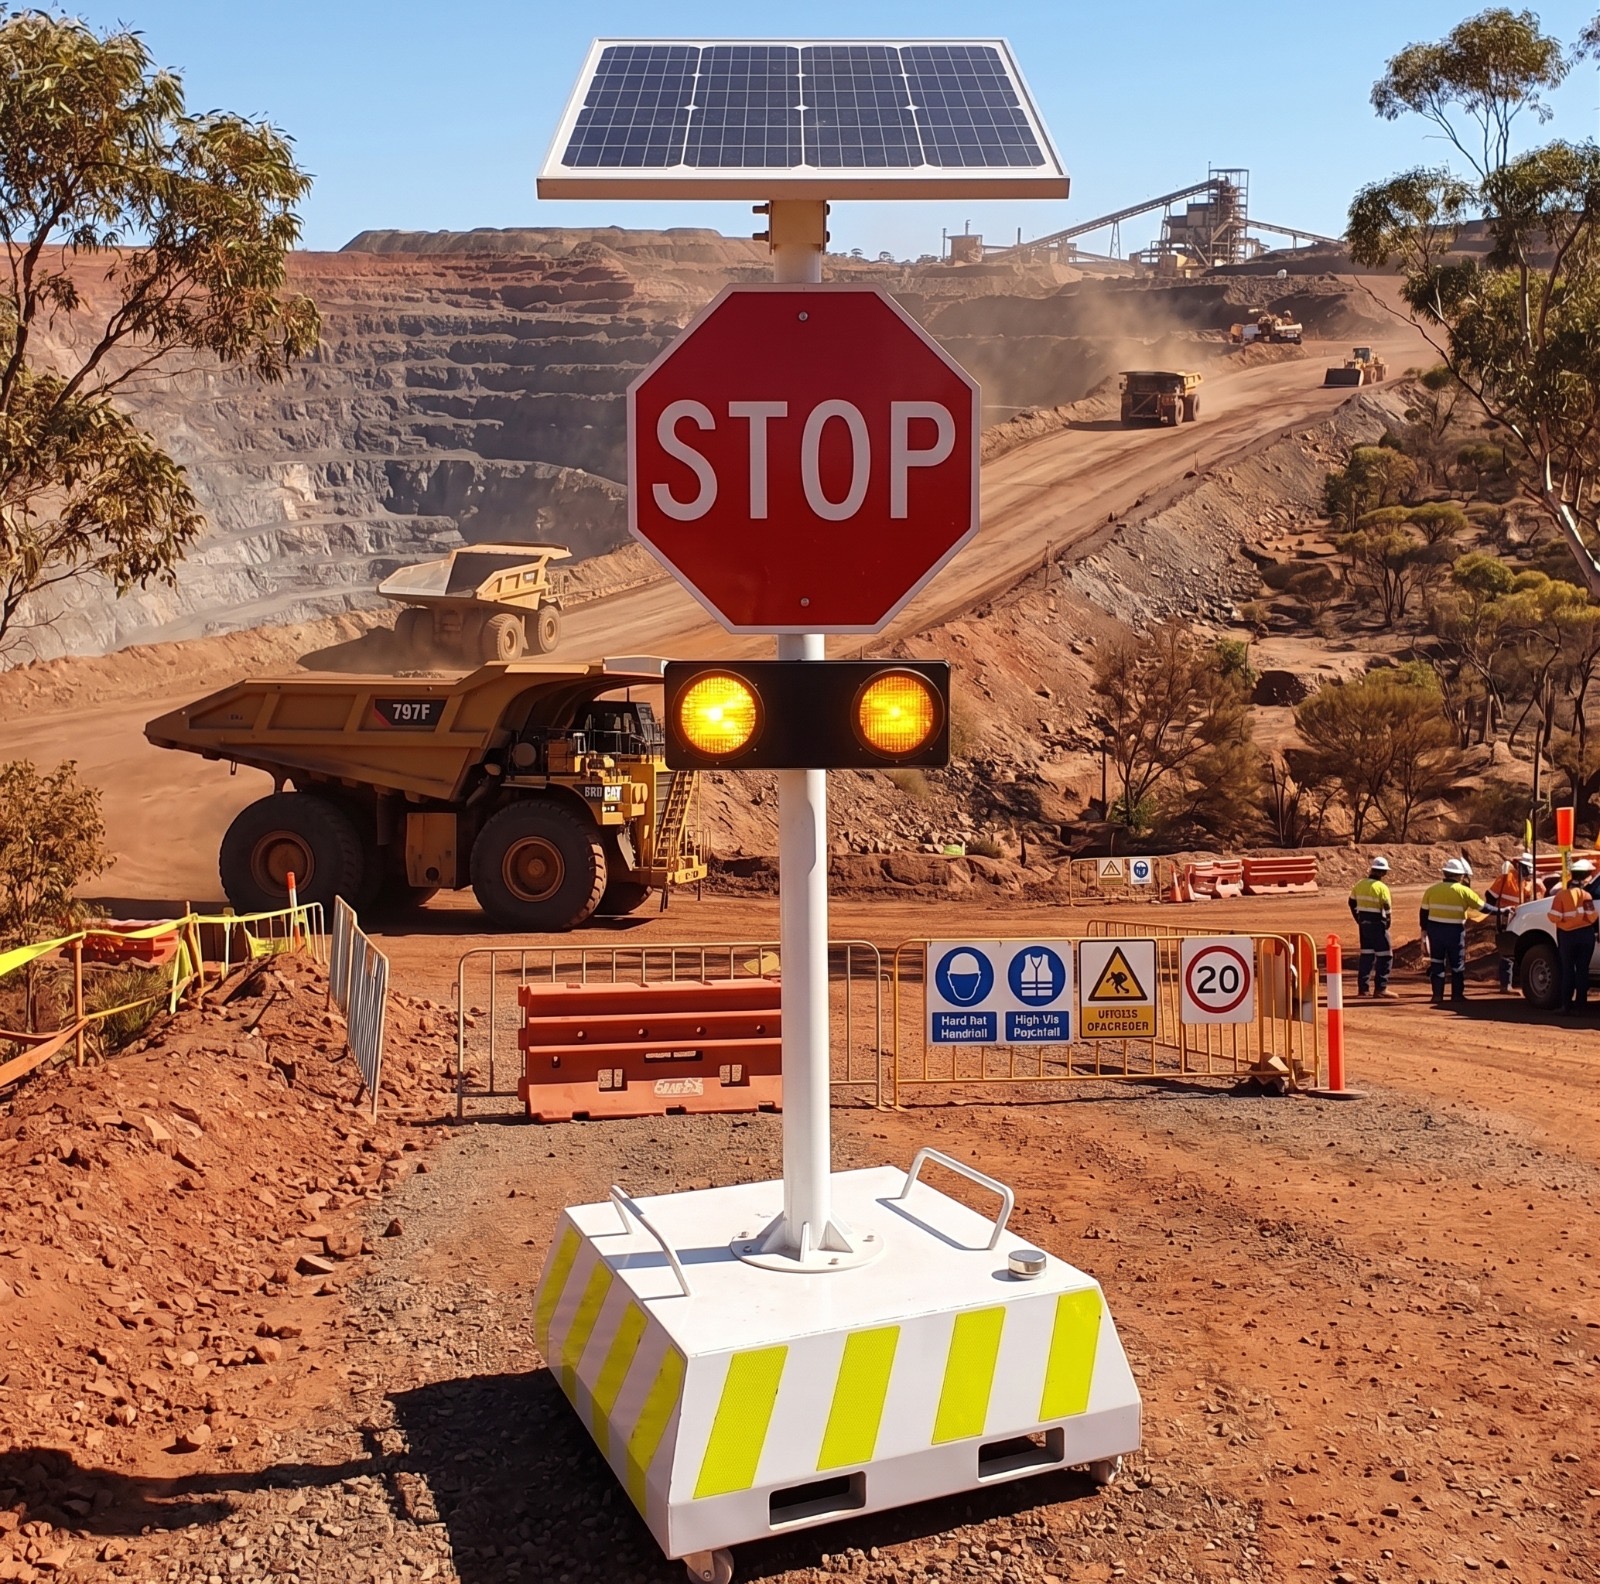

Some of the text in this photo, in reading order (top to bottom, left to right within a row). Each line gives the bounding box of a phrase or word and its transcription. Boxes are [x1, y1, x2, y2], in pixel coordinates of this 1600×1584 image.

[652, 399, 956, 521] STOP
[393, 704, 430, 720] 797F
[604, 786, 622, 799] CAT
[1197, 965, 1239, 994] 20
[941, 1015, 967, 1026] Hard
